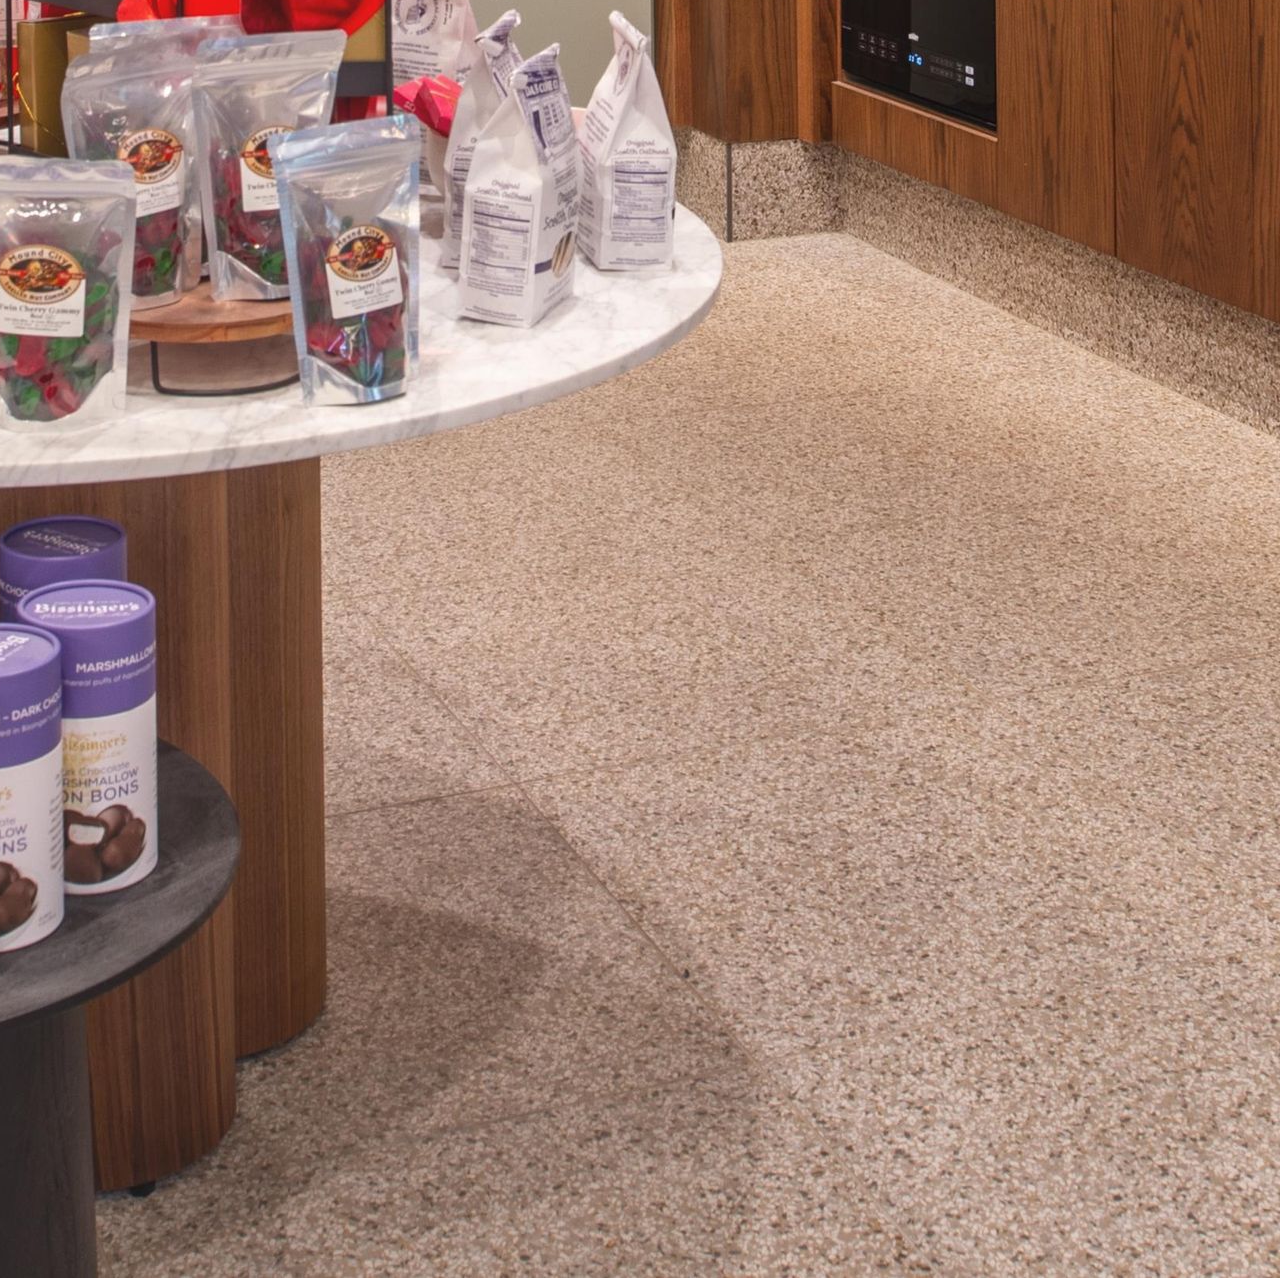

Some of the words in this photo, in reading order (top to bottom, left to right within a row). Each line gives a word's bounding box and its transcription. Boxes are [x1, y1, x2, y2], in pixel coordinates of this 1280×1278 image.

[8, 250, 44, 263] Mound
[19, 304, 47, 314] Cherry
[34, 600, 140, 615] Bissinger's
[11, 706, 43, 721] DARK
[88, 761, 131, 775] Chocolate
[90, 780, 140, 802] BONS
